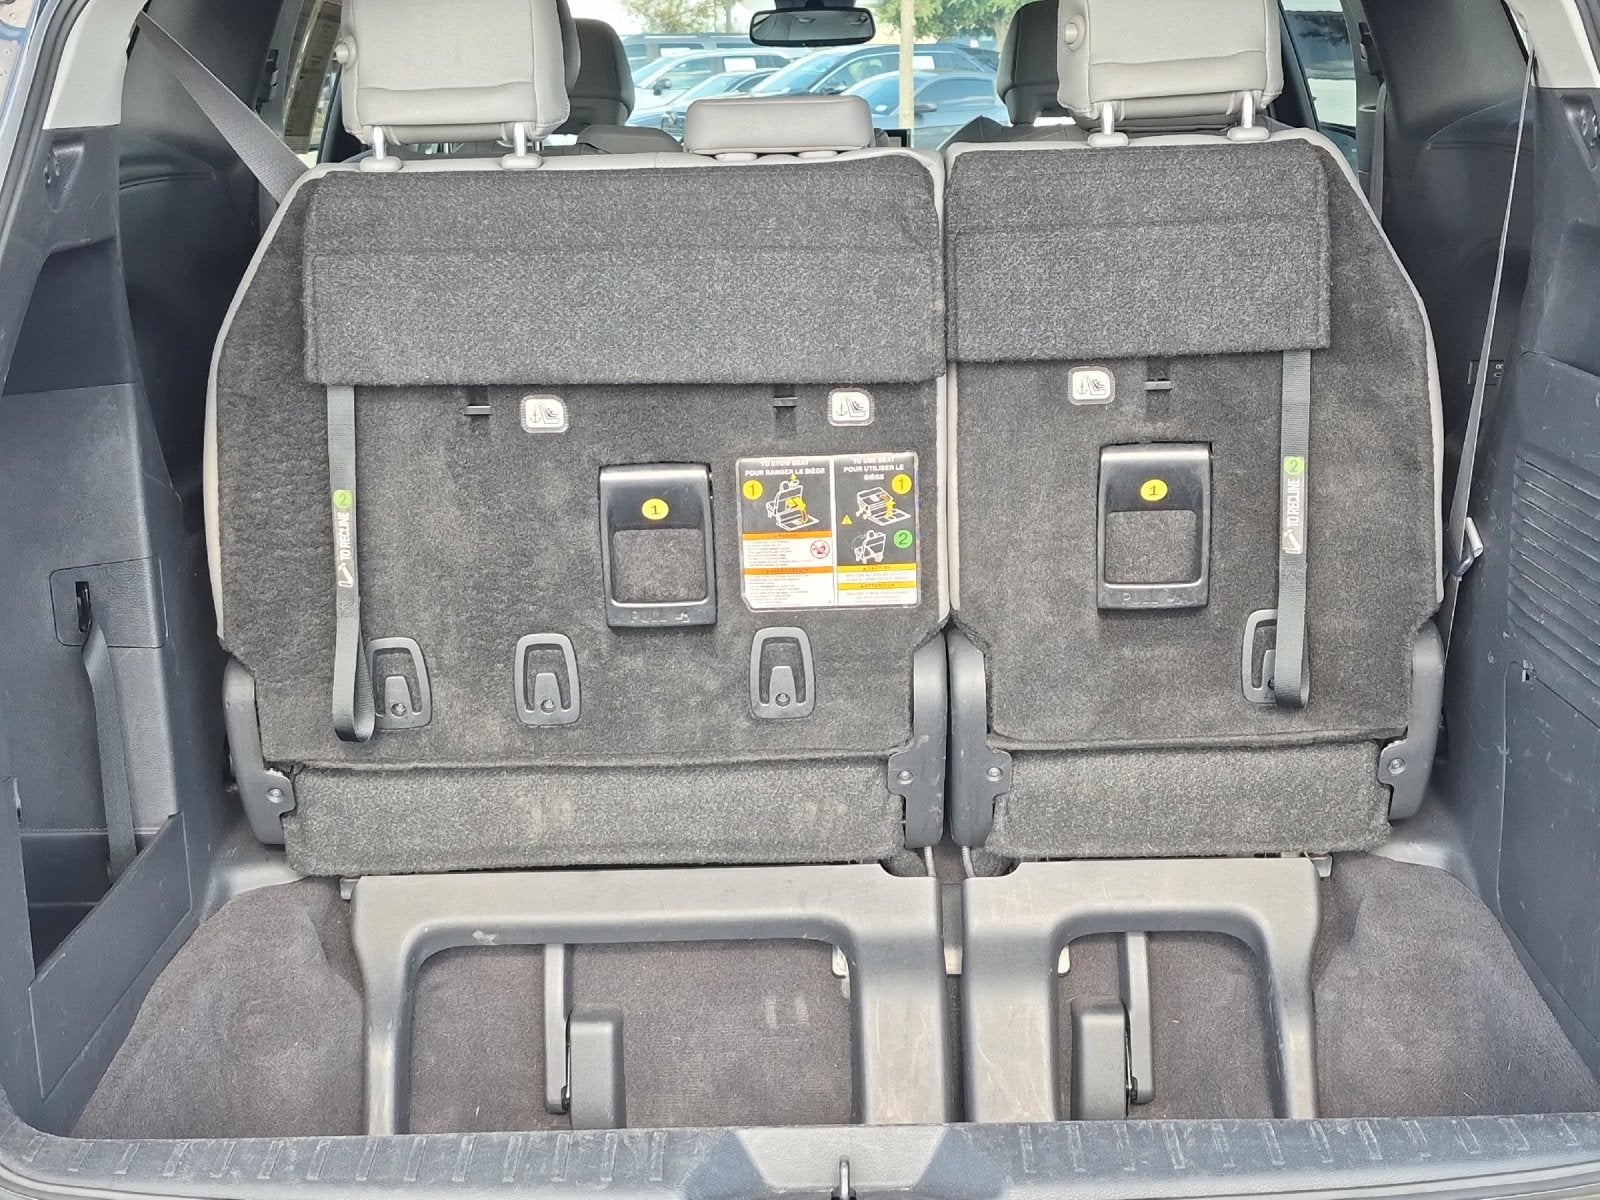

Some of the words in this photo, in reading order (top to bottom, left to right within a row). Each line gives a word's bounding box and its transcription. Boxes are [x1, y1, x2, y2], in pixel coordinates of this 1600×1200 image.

[1289, 460, 1298, 472] 2
[1149, 486, 1158, 496] 1
[1286, 478, 1300, 516] RECLINE
[339, 492, 347, 507] 2
[650, 504, 661, 514] 1
[1286, 516, 1300, 528] TO
[338, 512, 350, 548] RECLINE
[898, 532, 908, 545] 2
[340, 549, 352, 561] TO
